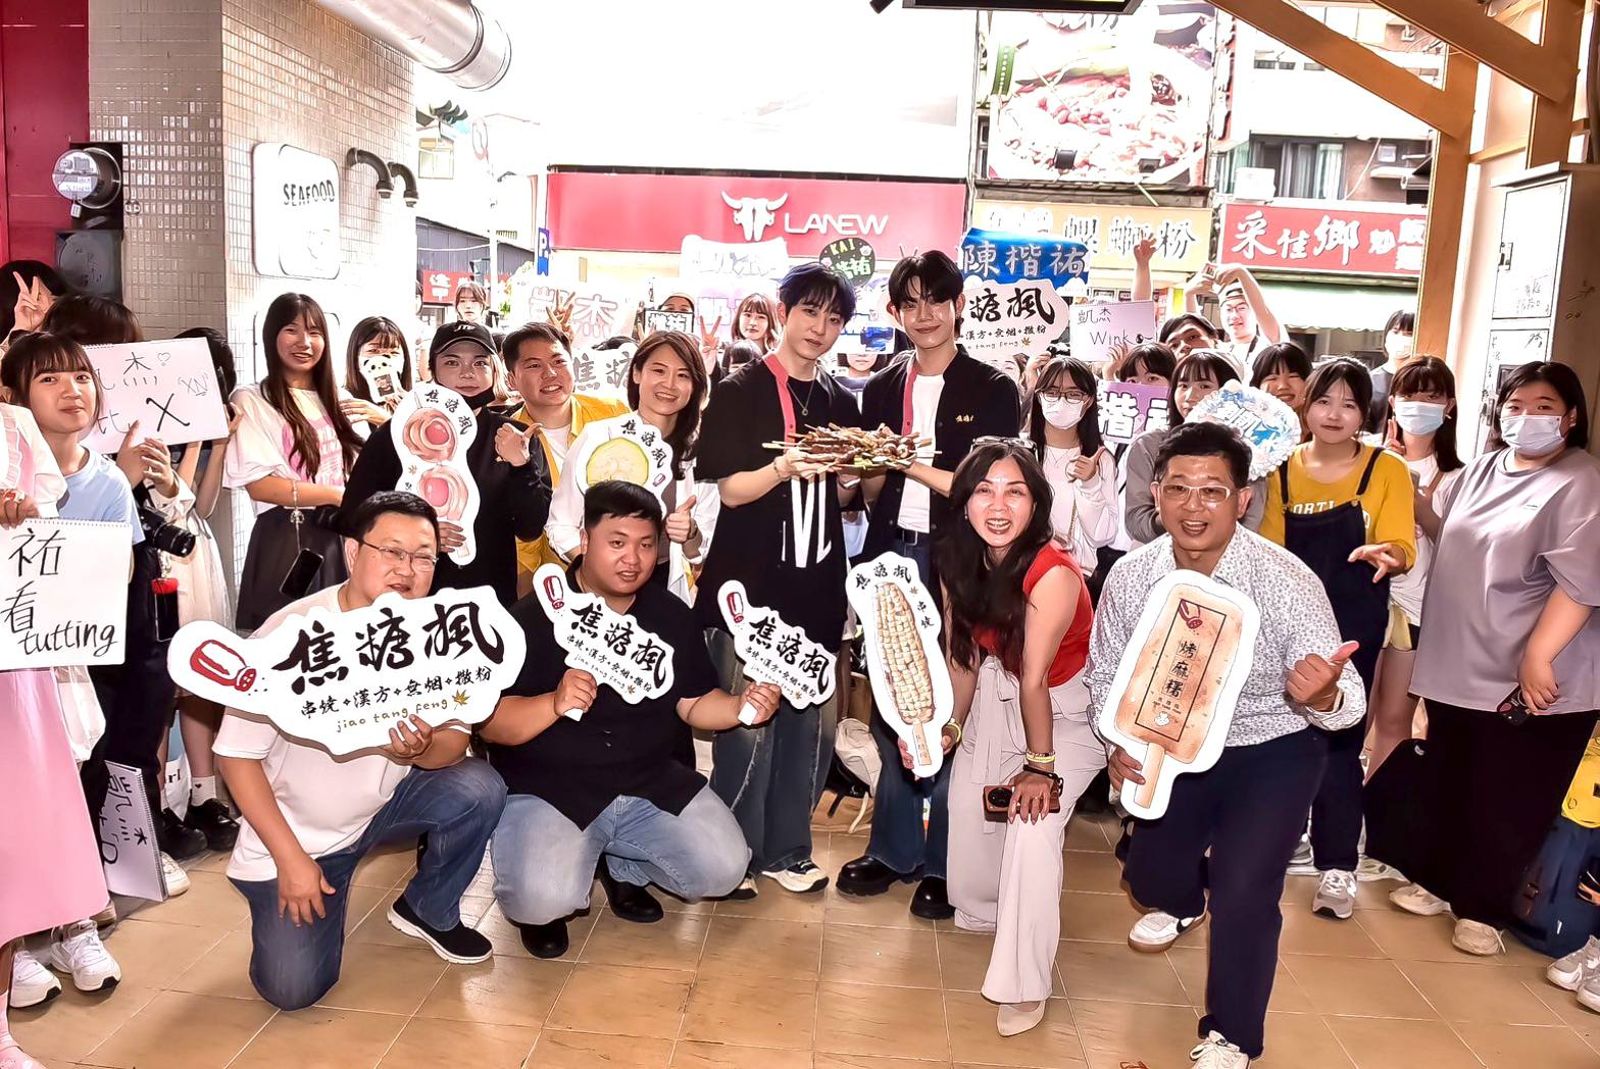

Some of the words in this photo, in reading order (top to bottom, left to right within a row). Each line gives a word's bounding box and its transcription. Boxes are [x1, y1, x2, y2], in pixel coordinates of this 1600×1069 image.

[284, 179, 335, 206] SEAFOOD
[830, 238, 856, 256] KAI
[962, 242, 1088, 278] 陳楷祐
[1078, 307, 1112, 325] 凱杰
[1090, 329, 1133, 346] Wink
[10, 527, 66, 578] 祐
[0, 581, 37, 634] 看
[18, 621, 119, 658] tutting
[272, 602, 505, 695] 焦糖楓
[336, 717, 367, 733] jiao
[373, 707, 409, 723] tang
